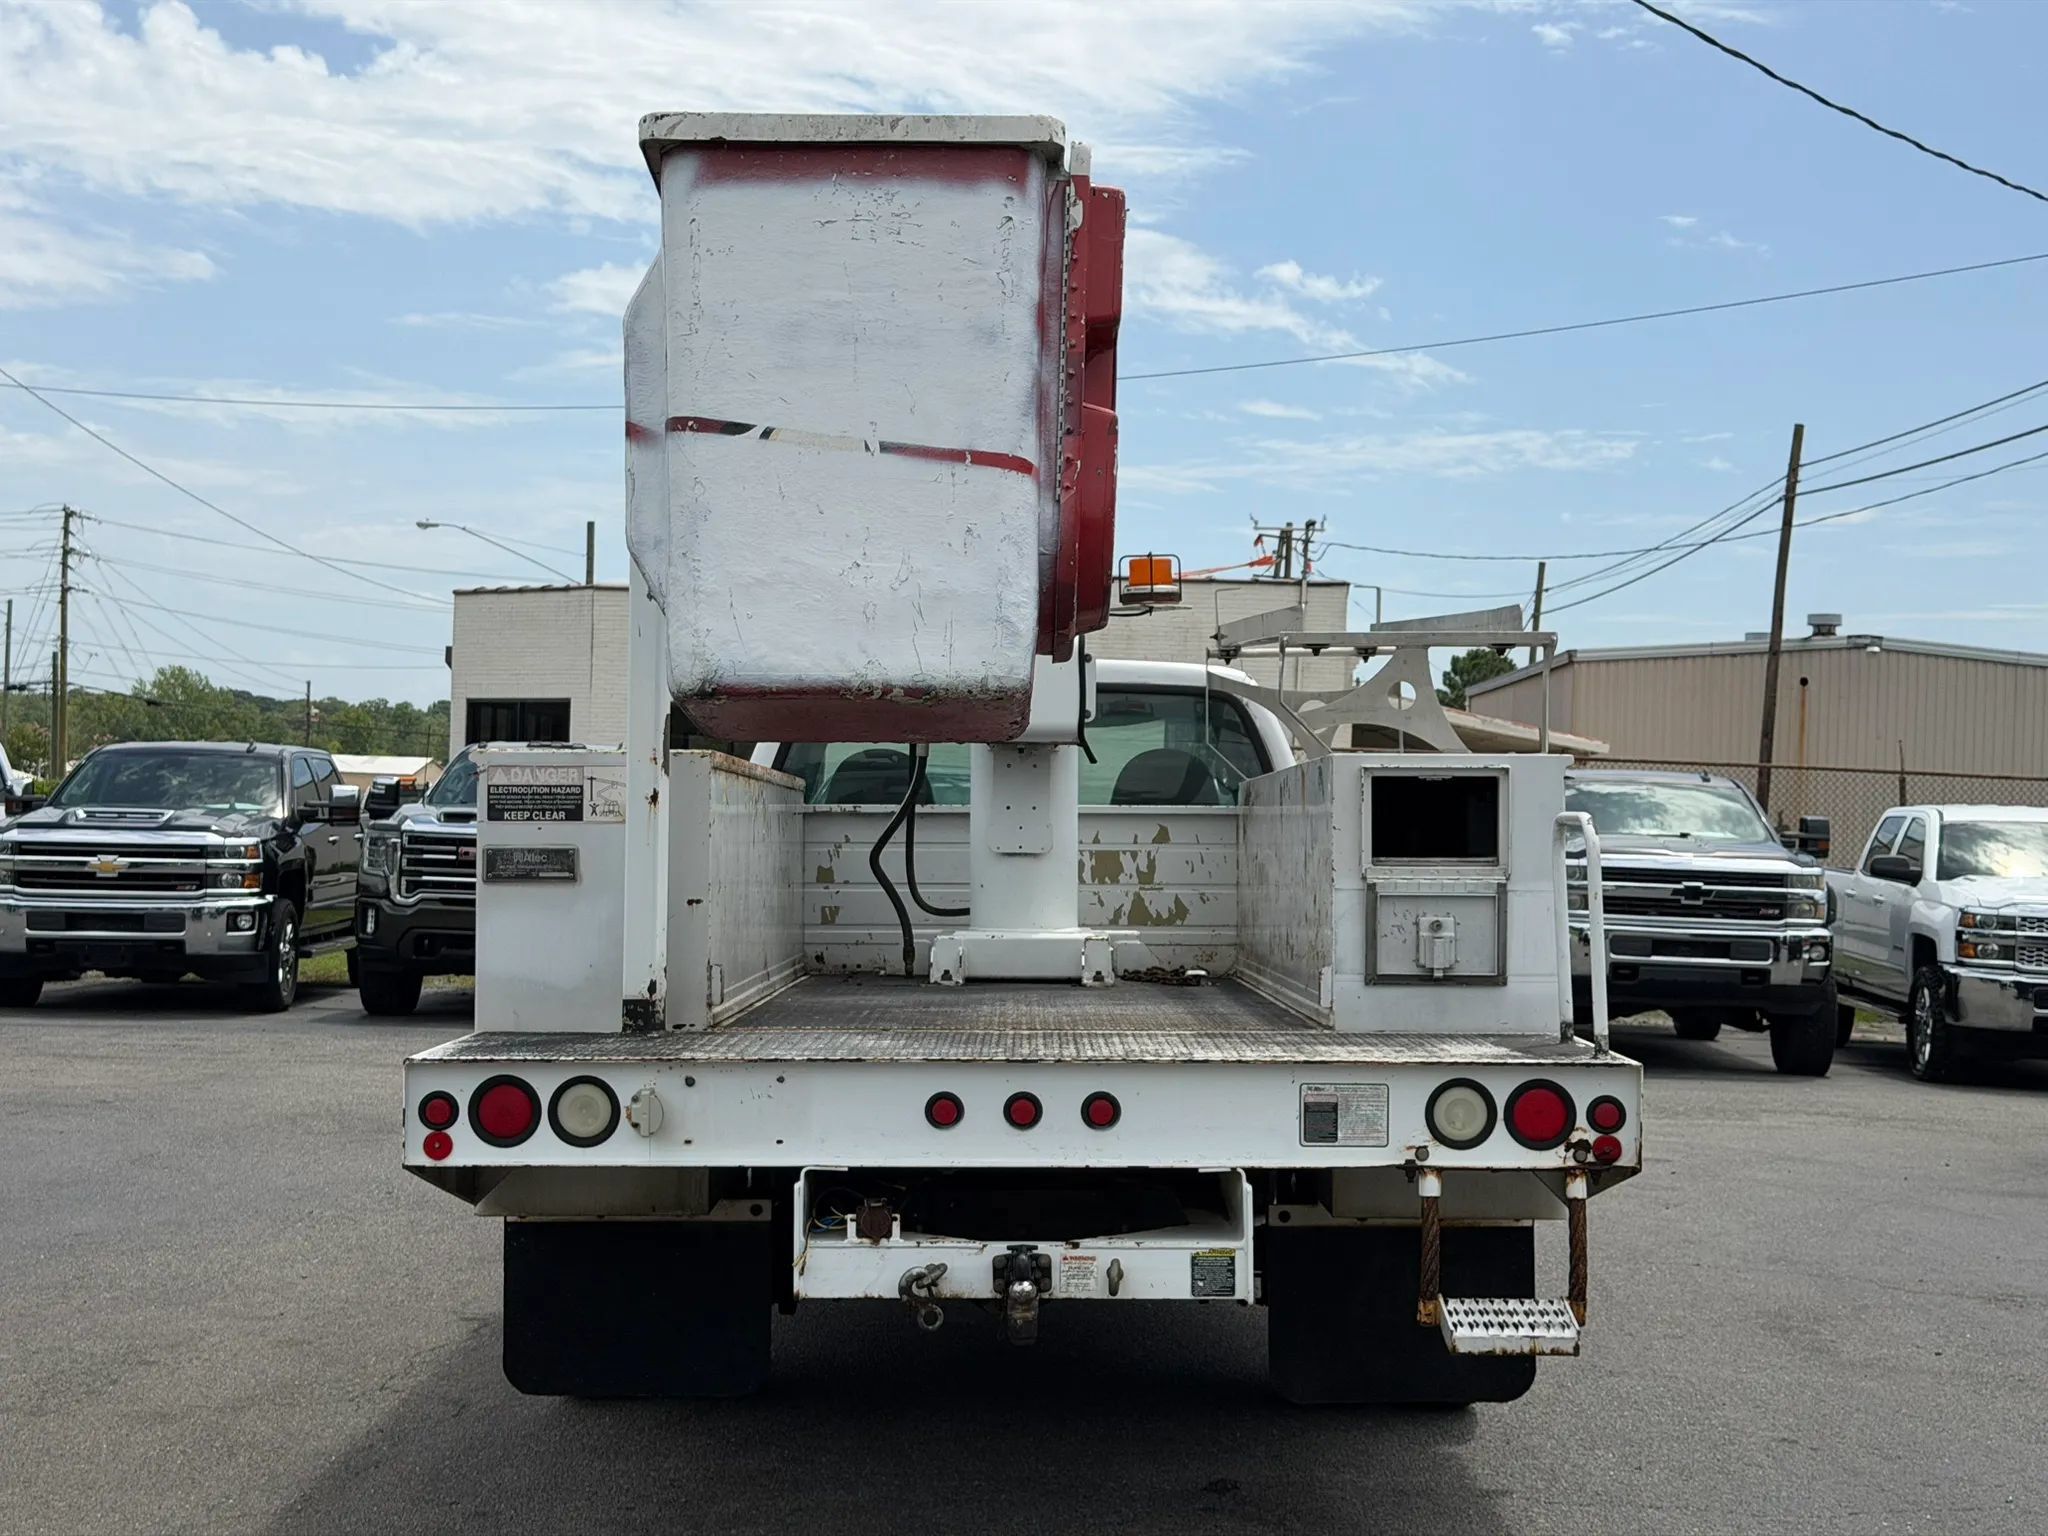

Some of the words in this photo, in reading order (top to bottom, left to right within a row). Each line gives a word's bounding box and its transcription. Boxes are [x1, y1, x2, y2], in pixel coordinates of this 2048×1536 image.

[510, 768, 578, 783] DANGER
[504, 811, 530, 820] KEEP
[532, 811, 565, 820] CLEAR
